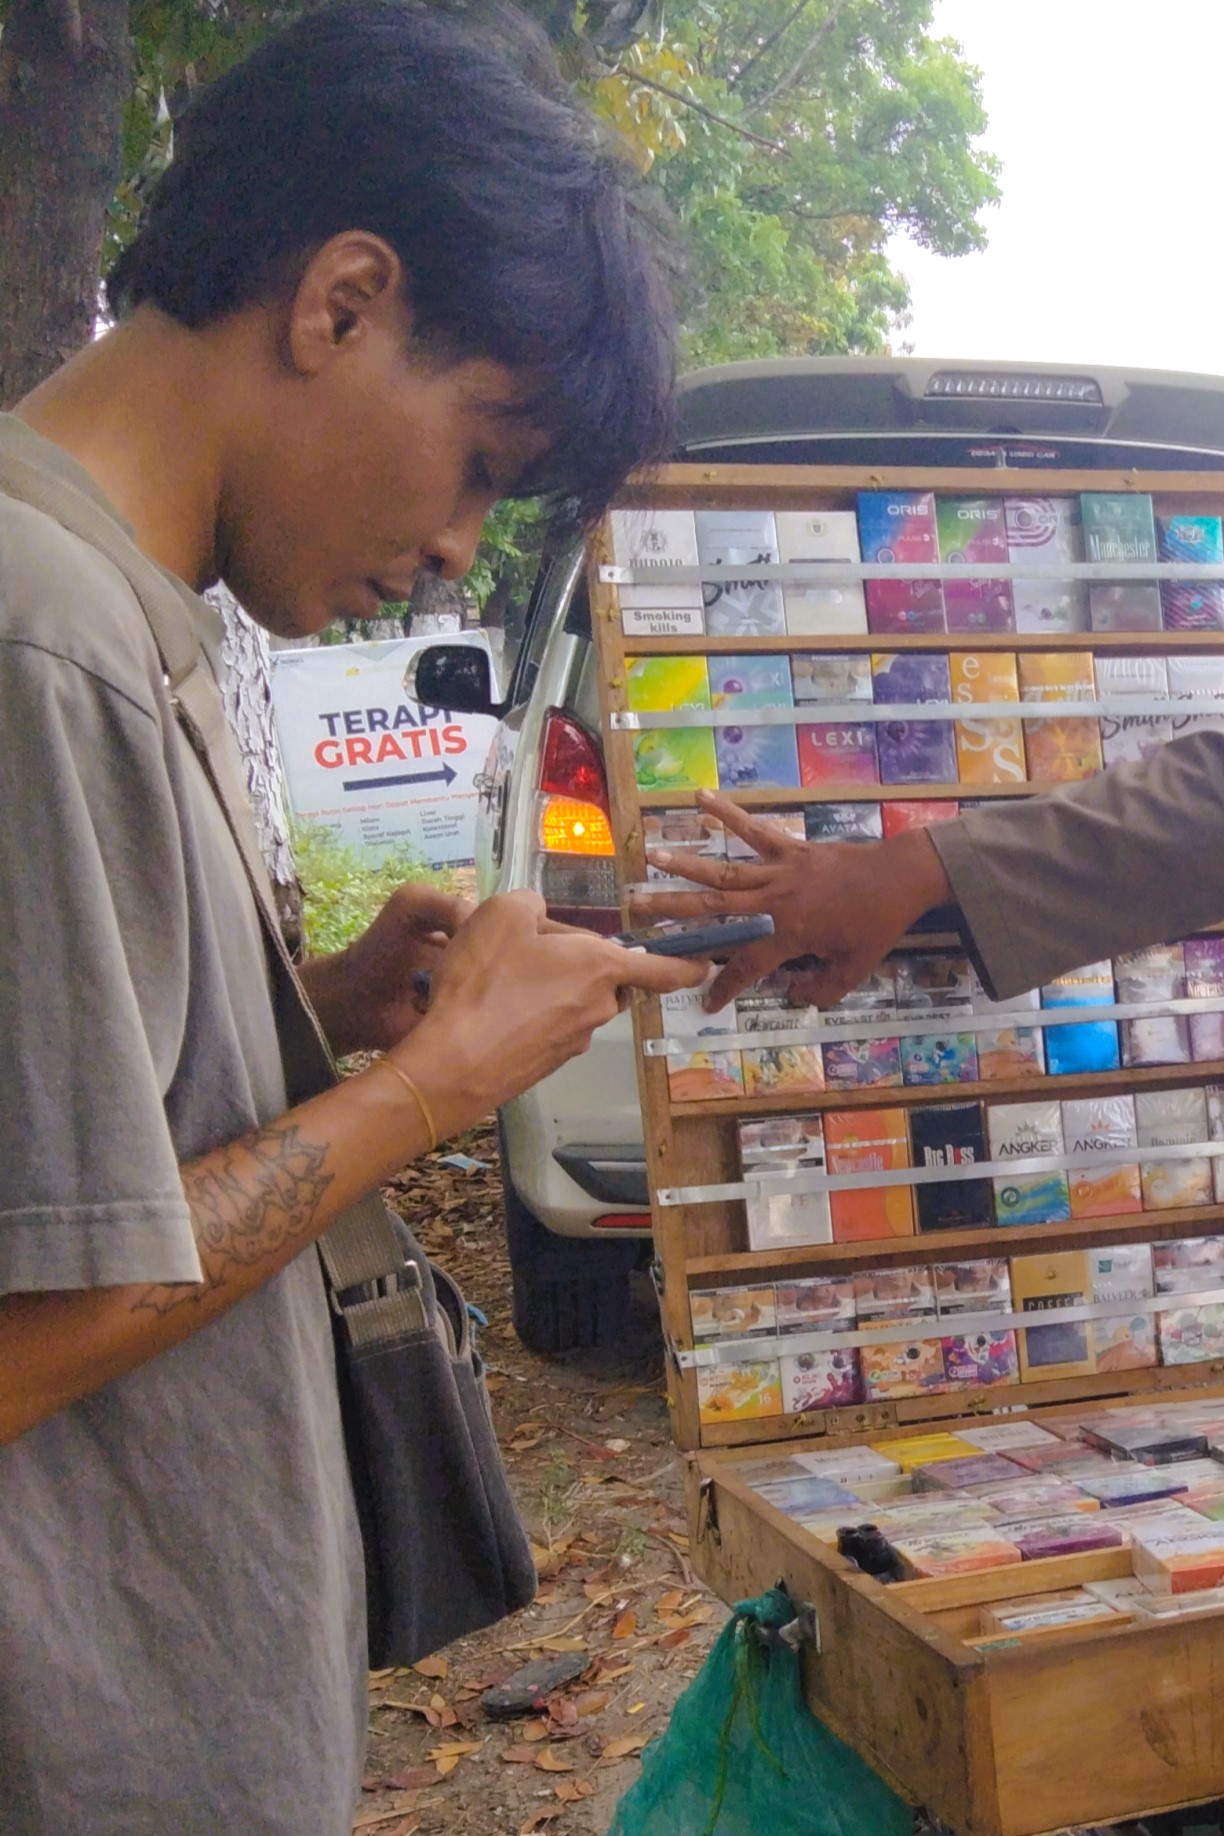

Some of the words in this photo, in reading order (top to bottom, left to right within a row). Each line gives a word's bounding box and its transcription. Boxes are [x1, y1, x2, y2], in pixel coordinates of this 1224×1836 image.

[886, 504, 929, 516] ORIS
[957, 509, 998, 520] ORIS
[1089, 534, 1150, 560] Manchester
[633, 610, 691, 623] Smoking
[650, 623, 678, 633] kills
[318, 705, 452, 737] TERAPI
[811, 731, 863, 746] LEXI
[314, 725, 467, 769] GRATIS
[998, 1138, 1059, 1156] ANGKER
[924, 1145, 945, 1167] BIG
